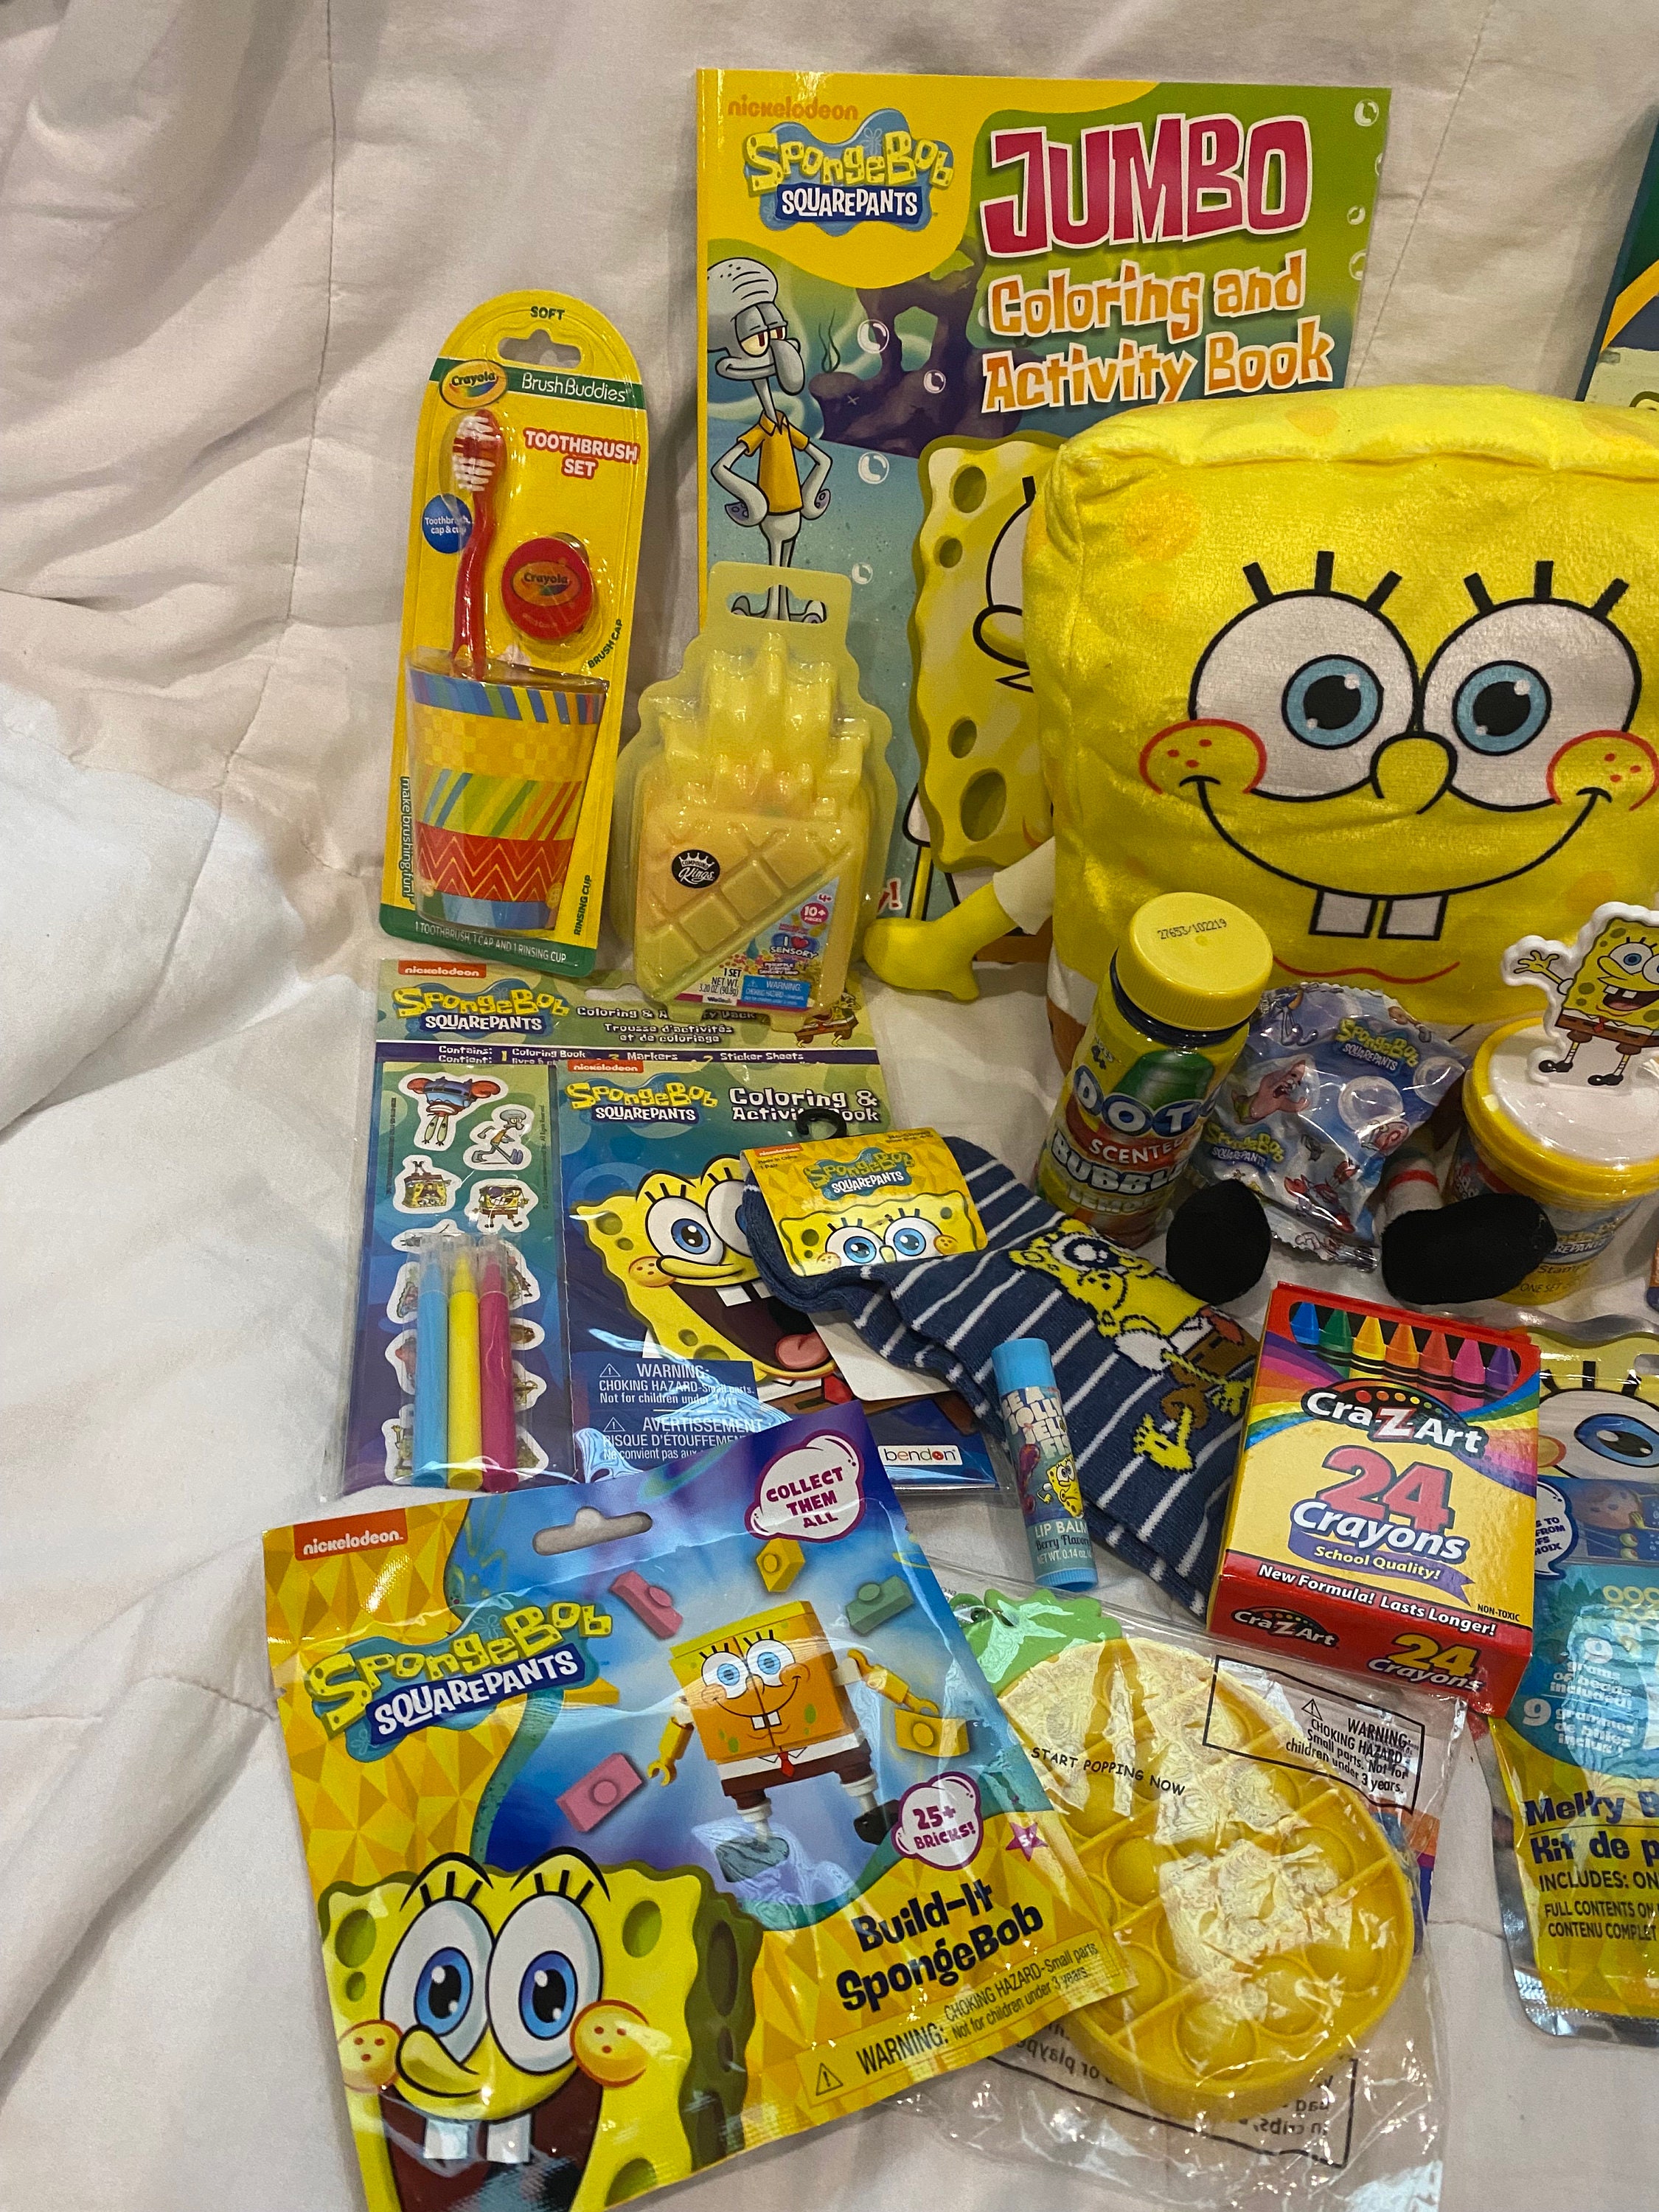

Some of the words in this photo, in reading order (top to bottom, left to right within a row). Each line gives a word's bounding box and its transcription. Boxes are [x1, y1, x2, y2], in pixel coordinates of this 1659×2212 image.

[727, 97, 859, 121] nickelodeon
[747, 127, 954, 191] SpongeBob
[981, 114, 1312, 259] JUMBO
[782, 189, 919, 218] SQUAREPANTS
[989, 257, 1201, 344] Coloring
[1213, 248, 1307, 316] and
[530, 306, 565, 321] SOFT
[981, 339, 1197, 414] Activity
[1203, 315, 1335, 397] Book
[451, 371, 495, 386] Crayola
[524, 429, 639, 462] TOOTHBRUSH
[564, 459, 597, 479] SET
[431, 527, 445, 536] cap
[445, 525, 451, 534] &
[524, 572, 568, 585] Crayola
[588, 639, 615, 668] BRUSH
[611, 619, 624, 641] CAP
[401, 778, 410, 812] make
[400, 815, 413, 872] brushing
[402, 872, 414, 897] fun!
[678, 867, 714, 884] Kings
[574, 897, 588, 936] RINSING
[581, 875, 593, 896] CUP
[804, 905, 826, 917] 10+
[420, 922, 472, 944] TOOTHBRUSH,
[479, 935, 493, 946] CAP
[495, 940, 512, 951] AND
[518, 945, 549, 960] RINSING
[551, 951, 566, 962] CUP
[771, 946, 818, 959] SENSORY
[405, 967, 479, 977] nickelodeon
[712, 977, 725, 987] NET
[728, 968, 742, 977] SET
[393, 987, 570, 1018] SpongeBob
[577, 1006, 637, 1019] Coloring
[641, 1009, 654, 1019] &
[425, 1015, 542, 1031] SQUAREPANTS
[605, 1023, 657, 1033] Trousse
[620, 1034, 634, 1042] et
[639, 1033, 654, 1042] de
[659, 1034, 720, 1043] coloriage
[1335, 1018, 1422, 1068] SpongeBob
[439, 1046, 493, 1055] Contains:
[512, 1048, 557, 1058] Coloring
[560, 1050, 585, 1058] Book
[627, 1052, 678, 1061] Markers
[720, 1053, 762, 1061] Sticker
[765, 1052, 804, 1060] Sheets
[439, 1055, 493, 1064] Contient:
[1342, 1043, 1399, 1071] SQUAREPANTS
[574, 1063, 638, 1072] nickelodeon
[566, 1082, 717, 1109] SpongeBob
[728, 1088, 846, 1107] Coloring
[856, 1090, 878, 1106] &
[596, 1107, 696, 1121] SQUAREPANTS
[1212, 1146, 1267, 1167] SQUAREPANTS
[804, 1152, 915, 1189] SpongeBob
[831, 1171, 905, 1194] SQUAREPANTS
[599, 1380, 648, 1392] CHOKING
[600, 1394, 618, 1403] Not
[622, 1393, 635, 1403] for
[639, 1393, 678, 1404] children
[682, 1395, 709, 1404] under
[1307, 1392, 1482, 1453] Cra-Z-Art
[603, 1434, 648, 1447] RISQUE
[603, 1449, 616, 1461] Ne
[620, 1447, 659, 1460] convient
[662, 1449, 678, 1461] pas
[884, 1448, 956, 1461] bendon
[766, 1467, 844, 1502] COLLECT
[1317, 1444, 1450, 1532] 24
[786, 1490, 838, 1516] THEM
[803, 1511, 838, 1528] ALL
[1034, 1523, 1052, 1538] LIP
[1056, 1520, 1088, 1534] BALM
[1293, 1500, 1467, 1562] Crayons
[1535, 1525, 1565, 1537] FROM
[1544, 1517, 1560, 1525] TO
[302, 1528, 404, 1556] nickelodeon
[1036, 1538, 1060, 1551] Berry
[1062, 1548, 1078, 1559] 0.14
[1314, 1546, 1368, 1566] School
[1373, 1558, 1441, 1580] Quality!
[1259, 1563, 1295, 1584] New
[1298, 1573, 1376, 1605] Formula!
[1380, 1596, 1425, 1618] Lasts
[1429, 1607, 1496, 1635] Longer!
[1477, 1603, 1521, 1622] NON-TOXIC
[1234, 1610, 1335, 1646] Cra-Z-Art
[1388, 1634, 1478, 1677] 24
[308, 1603, 612, 1738] SpongeBob
[1368, 1657, 1484, 1690] Crayons
[374, 1651, 579, 1736] SQUAREPANTS
[1523, 1698, 1551, 1727] 9
[1311, 1719, 1356, 1750] CHOKING
[1357, 1739, 1403, 1764] HAZARD
[1348, 1717, 1412, 1748] WARNING:
[1286, 1738, 1329, 1762] children
[1332, 1757, 1359, 1780] under
[1362, 1773, 1368, 1786] 3
[1371, 1778, 1404, 1794] years.
[1307, 1729, 1335, 1753] Small
[1337, 1747, 1365, 1770] parts.
[1368, 1759, 1387, 1775] Not
[1391, 1763, 1409, 1780] for
[1031, 1747, 1078, 1768] START
[1083, 1759, 1144, 1781] POPPING
[1149, 1775, 1186, 1796] NOW
[913, 1806, 956, 1829] 25+
[1524, 1790, 1625, 1826] Melty
[1530, 1833, 1576, 1864] Kit
[1589, 1831, 1630, 1860] de
[1539, 1870, 1629, 1893] INCLUDES:
[852, 1878, 993, 1952] Build-It
[1545, 1901, 1573, 1918] FULL
[1574, 1900, 1635, 1917] CONTENTS
[1637, 1902, 1655, 1917] ON
[1548, 1921, 1603, 1938] CONTENU
[1605, 1922, 1657, 1941] COMPLET
[836, 1902, 1044, 2012] SpongeBob
[944, 1987, 996, 2022] CHOKING
[1072, 1941, 1099, 1965] parts
[856, 2023, 949, 2075] WARNING:
[952, 2023, 969, 2041] Not
[970, 2017, 984, 2034] for
[987, 1998, 1024, 2028] children
[1026, 1982, 1051, 2005] under
[1052, 1975, 1061, 1990] 3
